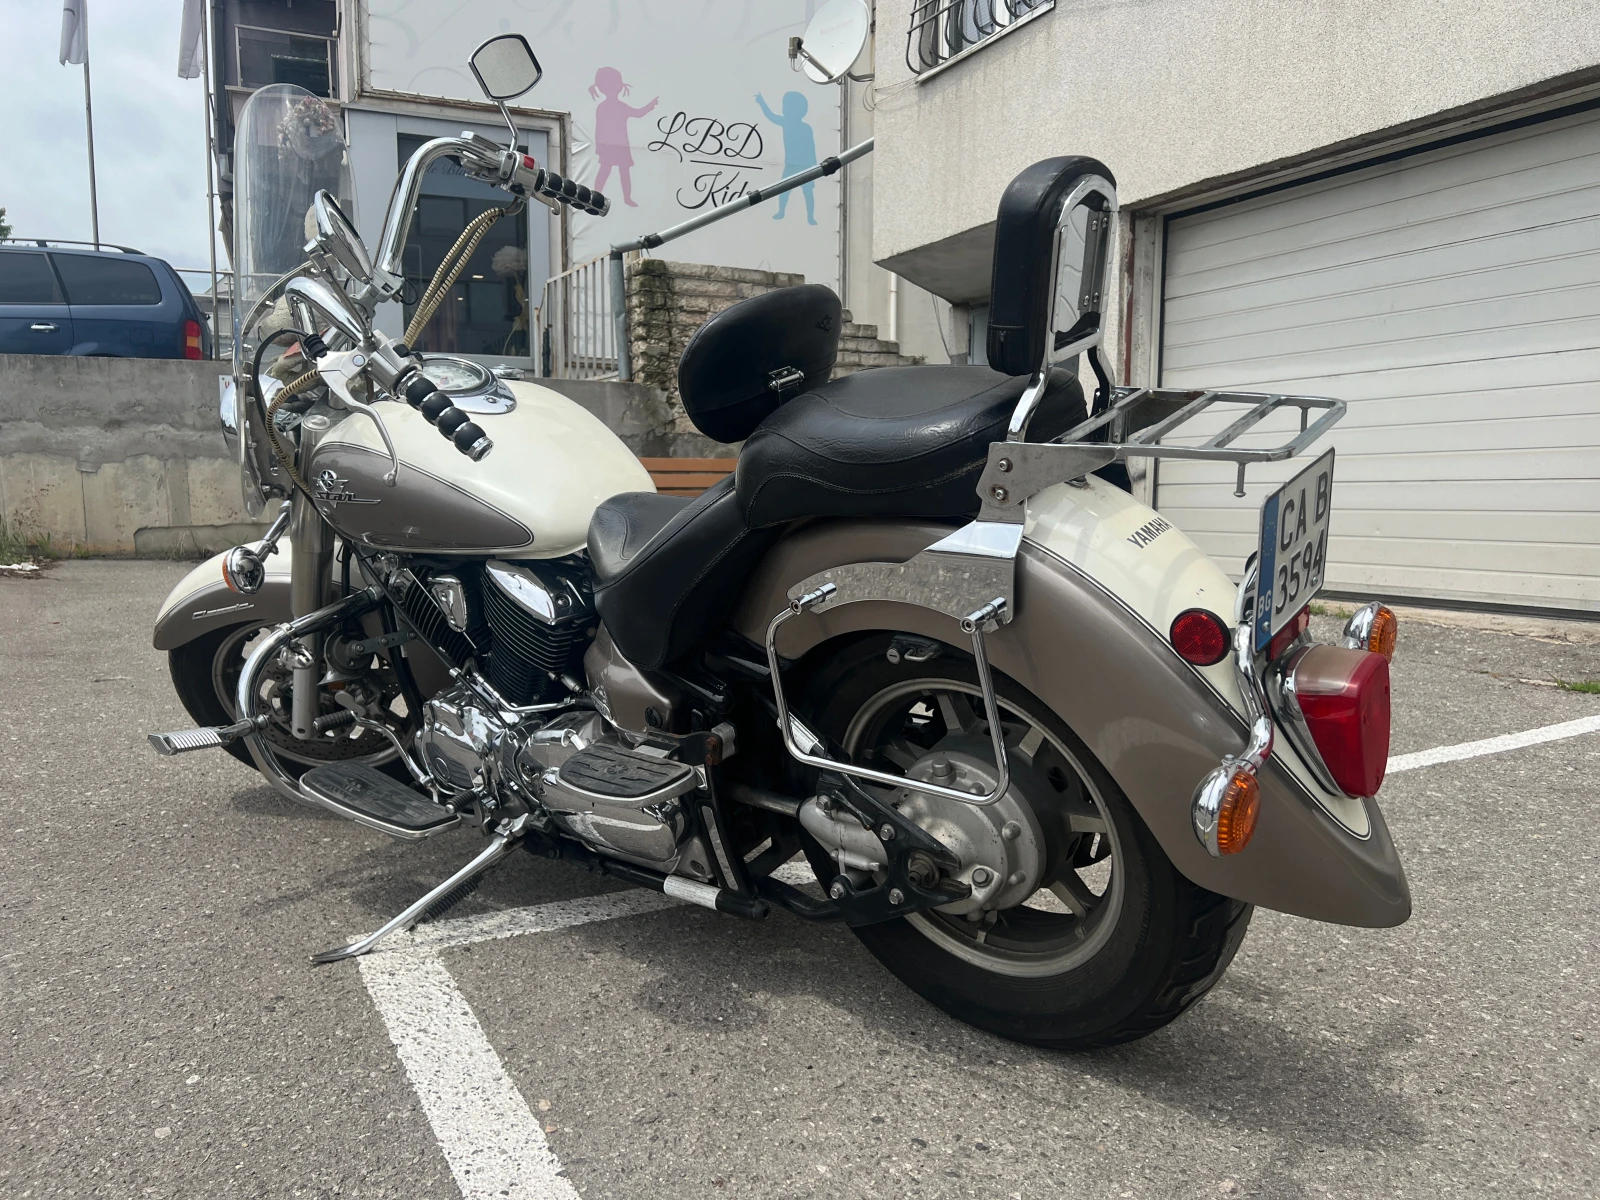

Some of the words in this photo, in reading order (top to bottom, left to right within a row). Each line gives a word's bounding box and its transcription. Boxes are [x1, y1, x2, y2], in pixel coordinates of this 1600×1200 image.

[647, 111, 764, 164] LBD
[1126, 516, 1173, 549] YAMAHA
[1279, 487, 1307, 552] CA
[1314, 471, 1328, 525] B
[1275, 529, 1325, 615] 3594
[1257, 589, 1272, 620] BG
